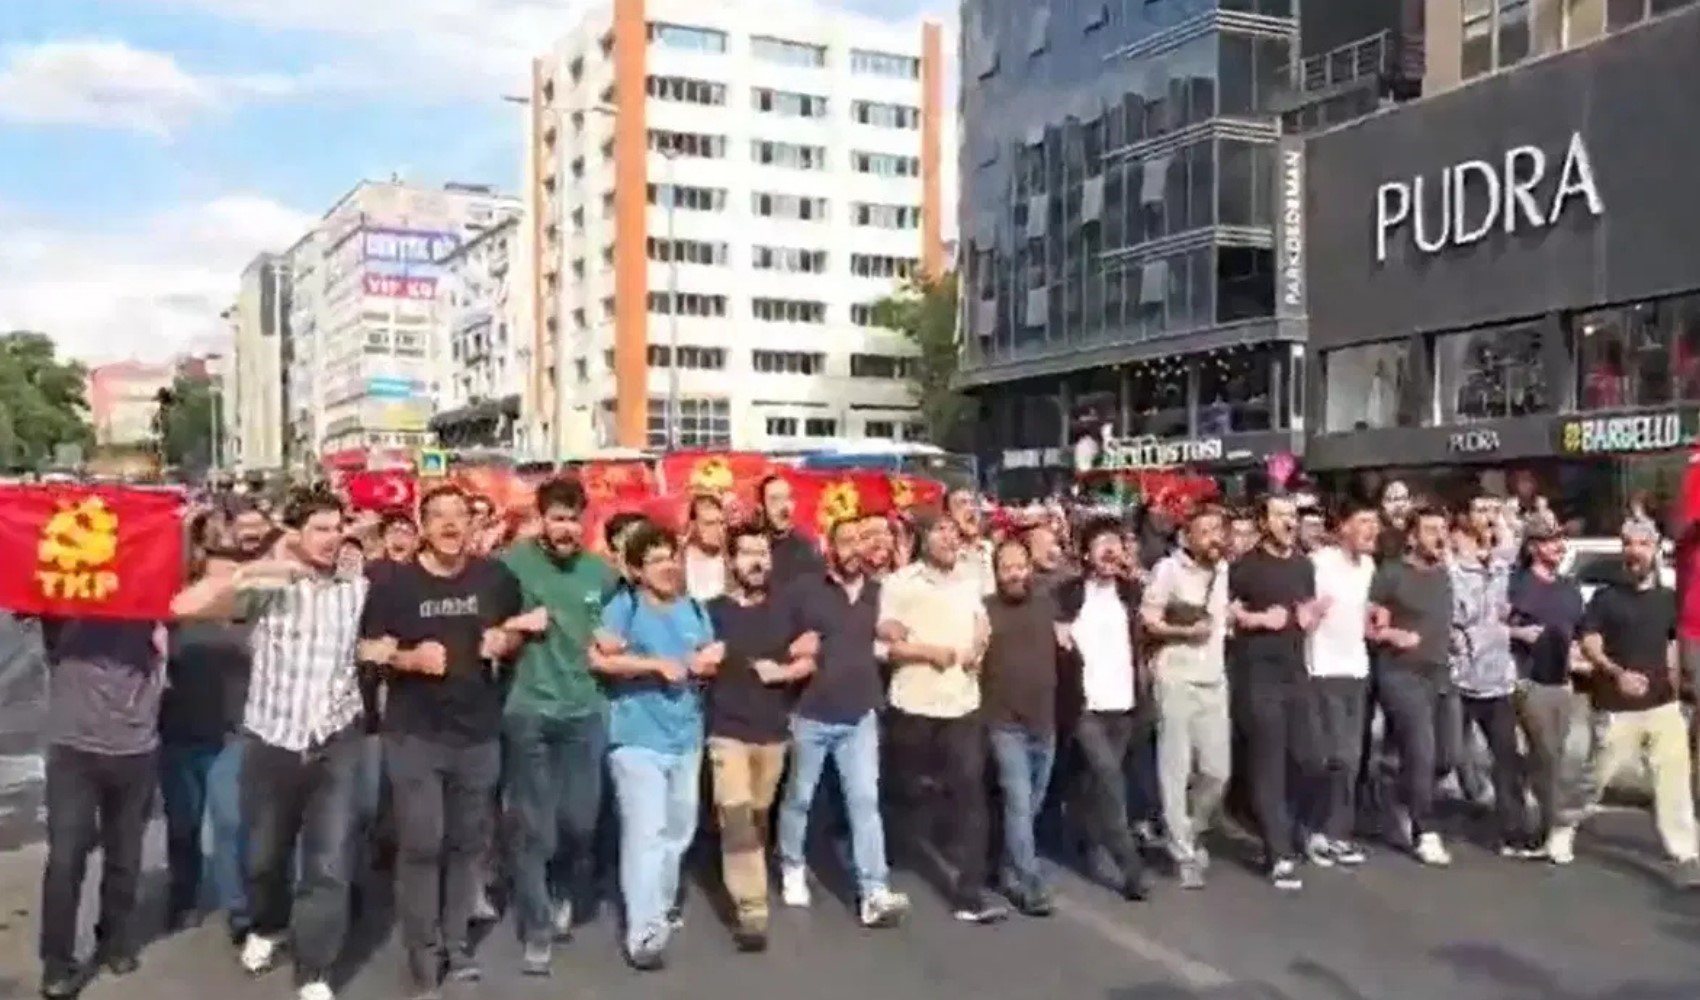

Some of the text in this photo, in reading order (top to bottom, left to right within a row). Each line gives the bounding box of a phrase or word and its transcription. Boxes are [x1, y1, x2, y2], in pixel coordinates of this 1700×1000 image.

[1377, 131, 1605, 261] PUDRA
[1450, 430, 1500, 451] PUDRA
[34, 570, 120, 600] TKP
